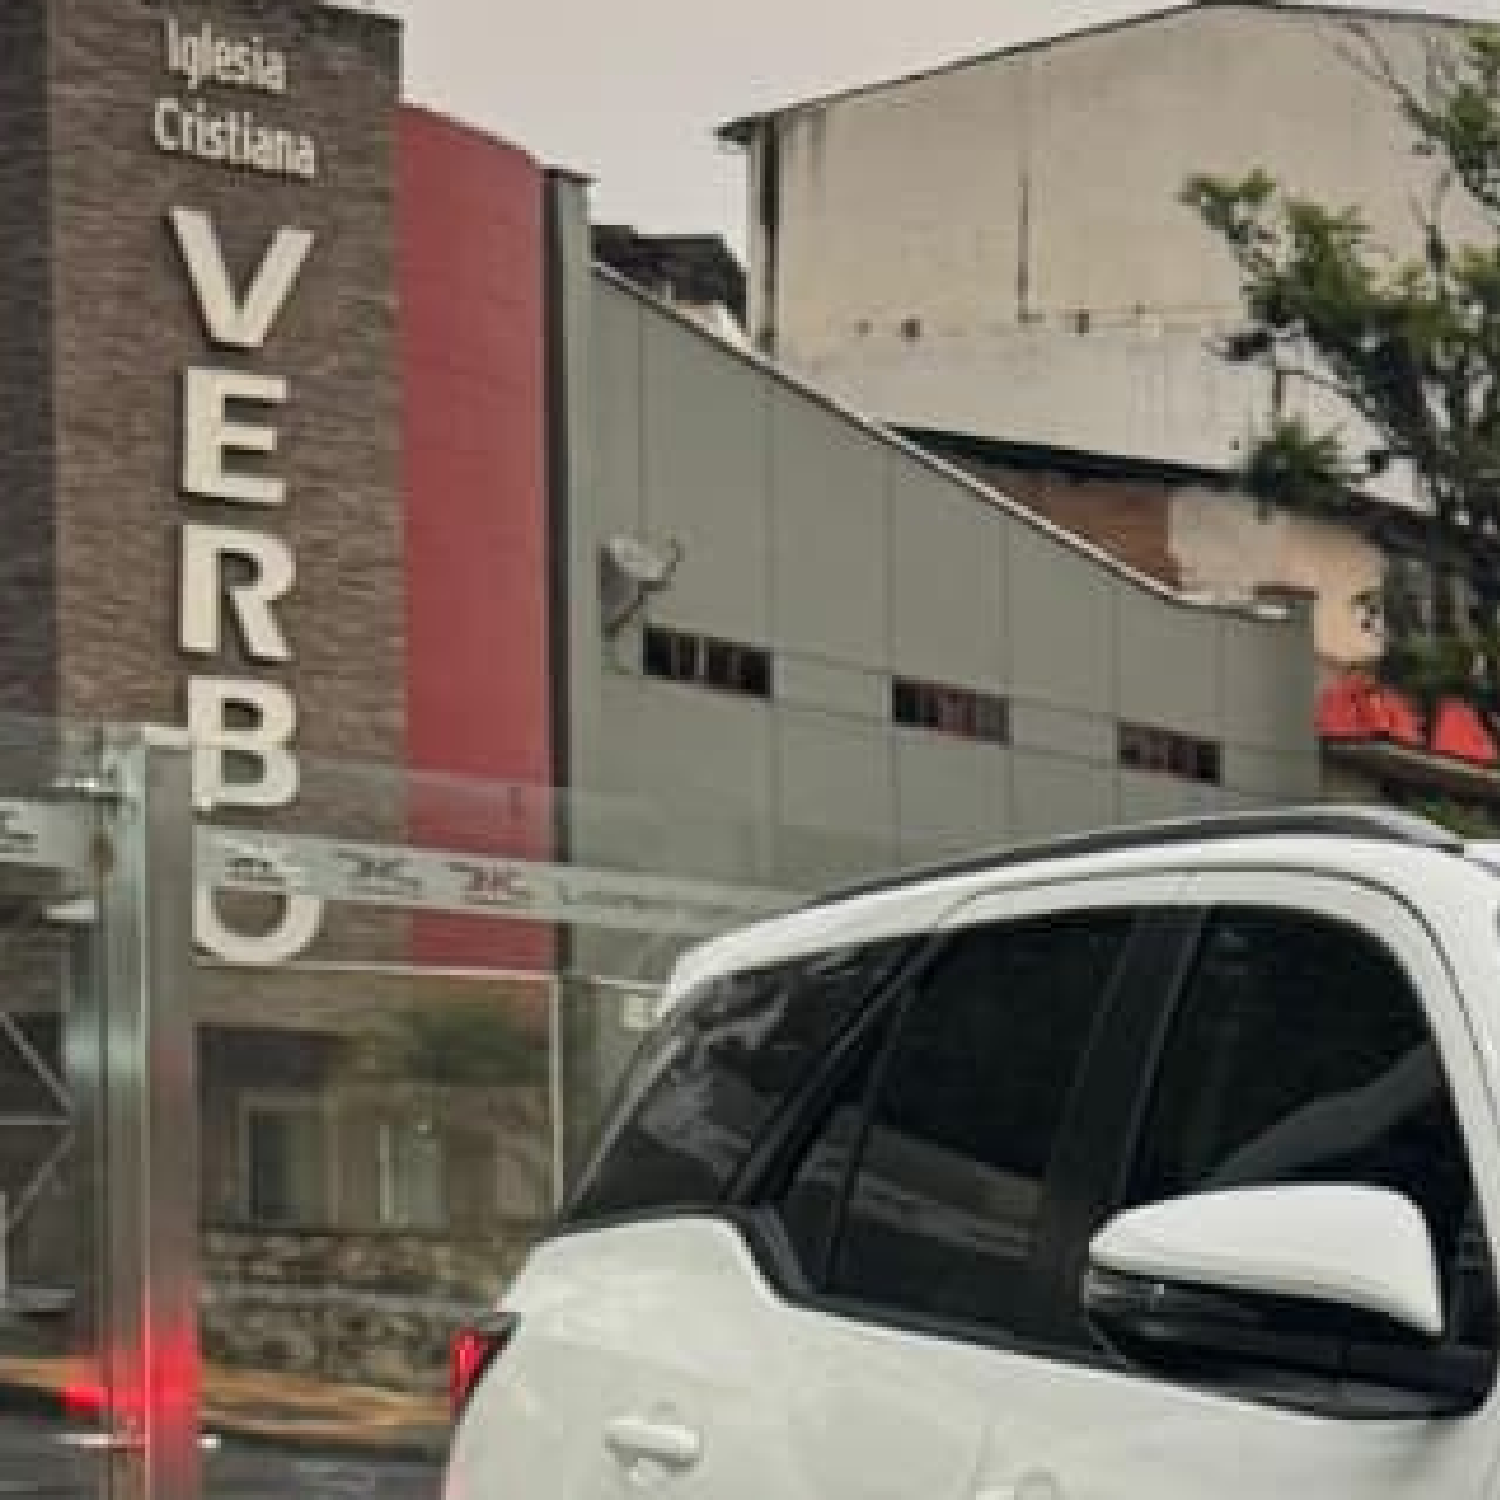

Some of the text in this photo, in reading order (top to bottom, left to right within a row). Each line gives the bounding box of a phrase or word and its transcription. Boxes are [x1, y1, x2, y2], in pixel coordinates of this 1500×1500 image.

[166, 20, 287, 92] Iglesia
[153, 97, 317, 178] Cristiana
[168, 206, 322, 964] VERBO
